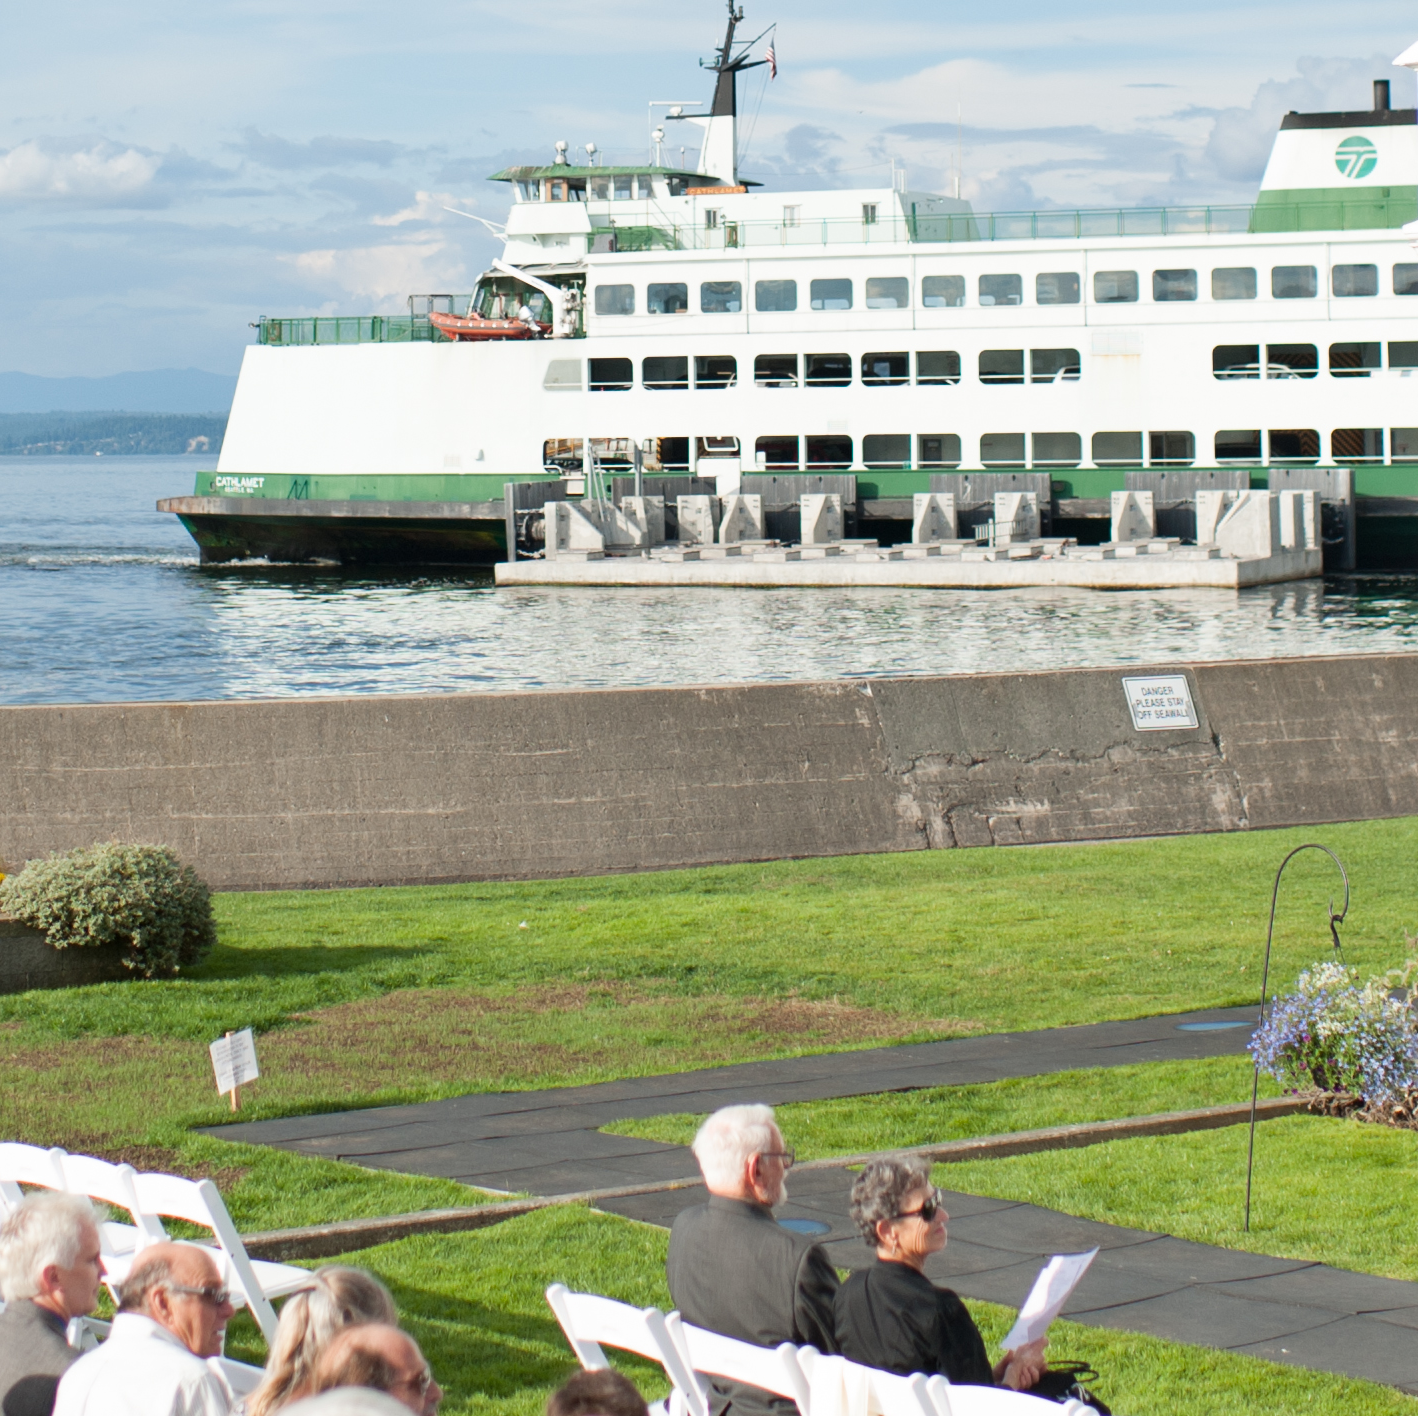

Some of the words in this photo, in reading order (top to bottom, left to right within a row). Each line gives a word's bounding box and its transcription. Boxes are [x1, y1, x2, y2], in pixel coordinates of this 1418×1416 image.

[689, 186, 744, 195] CATHLAMET
[215, 476, 265, 488] CATHLAMET
[1141, 686, 1174, 696] DANGER
[1135, 698, 1166, 708] PLEASE
[1167, 697, 1184, 706] STAY
[1136, 710, 1152, 720] OFF
[1154, 709, 1189, 719] SEAWALL
